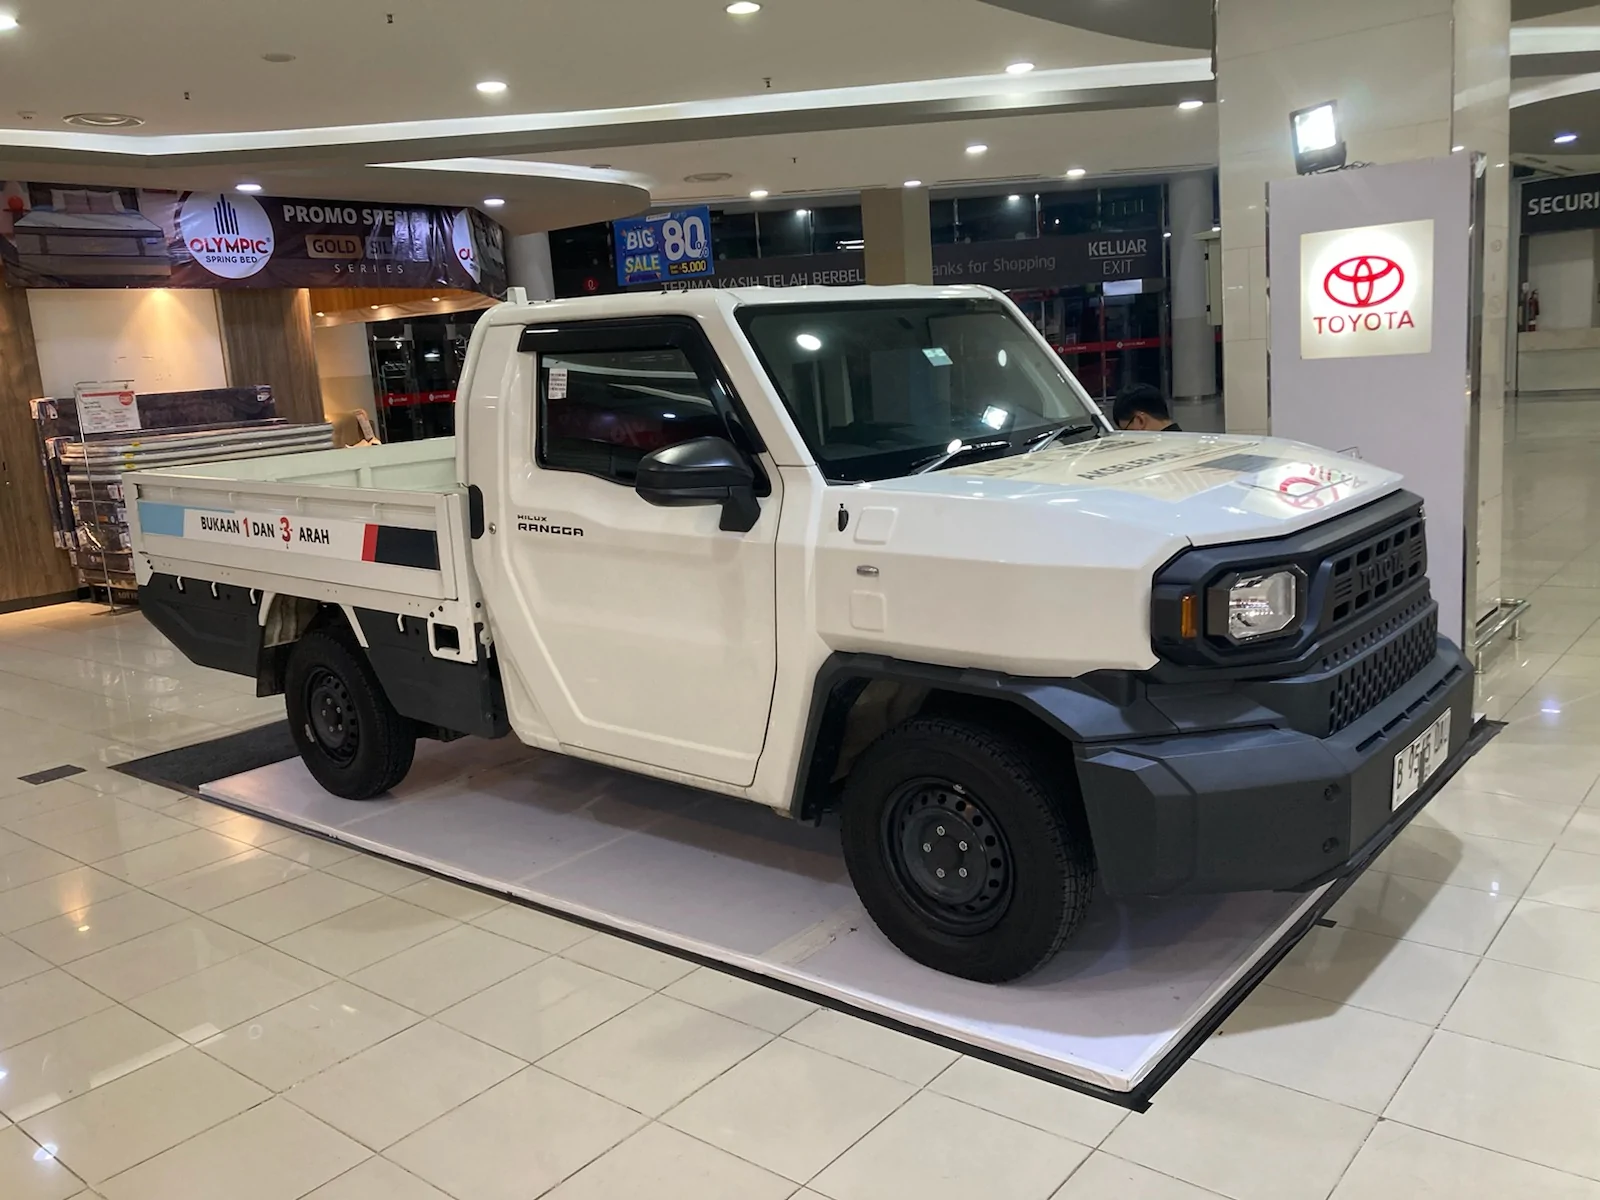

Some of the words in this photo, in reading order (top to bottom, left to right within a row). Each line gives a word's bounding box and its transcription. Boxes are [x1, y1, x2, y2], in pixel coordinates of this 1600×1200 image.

[1527, 191, 1600, 215] SECURI
[282, 204, 357, 224] PROMO
[189, 237, 269, 254] OLYMPIC
[312, 239, 357, 255] GOLD
[627, 229, 654, 250] BIG
[662, 216, 709, 261] 80%
[1088, 239, 1147, 257] KELUAR
[206, 255, 237, 264] SPRING
[240, 255, 258, 264] BED
[625, 254, 660, 274] SALE
[682, 260, 707, 274] 5.000
[932, 262, 963, 276] anks
[968, 260, 989, 273] for
[993, 256, 1056, 273] Shopping
[1103, 259, 1134, 275] EXIT
[334, 263, 404, 275] SERIES
[718, 276, 760, 288] KASIH
[764, 272, 808, 287] TELAH
[812, 269, 864, 285] BERBEL
[1313, 310, 1415, 335] TOYOTA
[517, 514, 548, 522] HILUX
[200, 516, 240, 534] BUKAAN
[243, 517, 250, 538] 1
[252, 521, 275, 538] DAN
[280, 516, 291, 543] 3
[299, 527, 330, 545] ARAH
[518, 523, 584, 537] RANGGA
